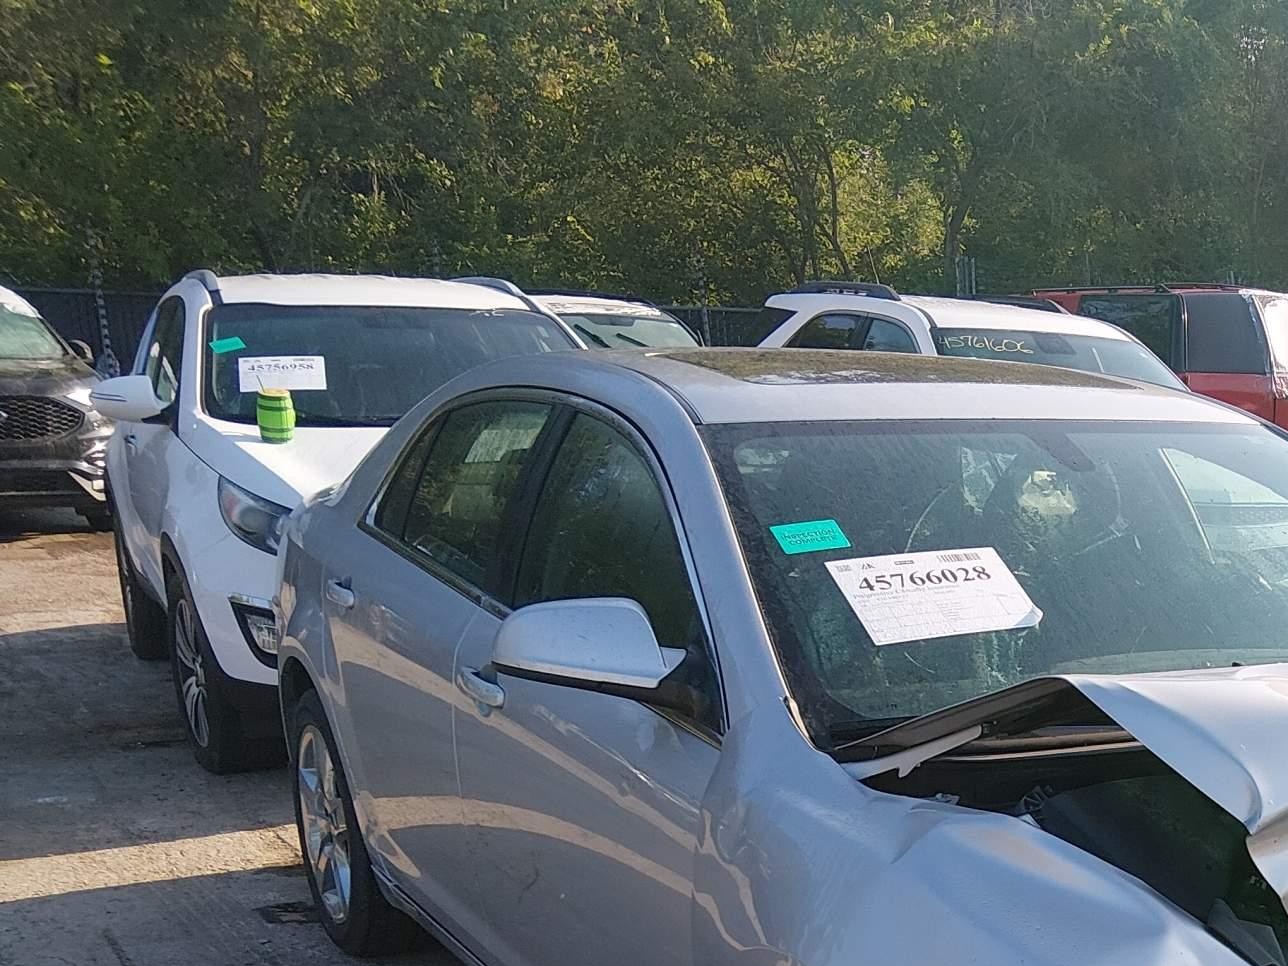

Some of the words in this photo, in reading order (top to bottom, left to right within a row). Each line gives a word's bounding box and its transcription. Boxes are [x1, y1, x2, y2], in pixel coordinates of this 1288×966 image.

[782, 527, 835, 541] INSPECTION
[788, 534, 837, 546] COMPLETE
[859, 566, 992, 592] 45766028
